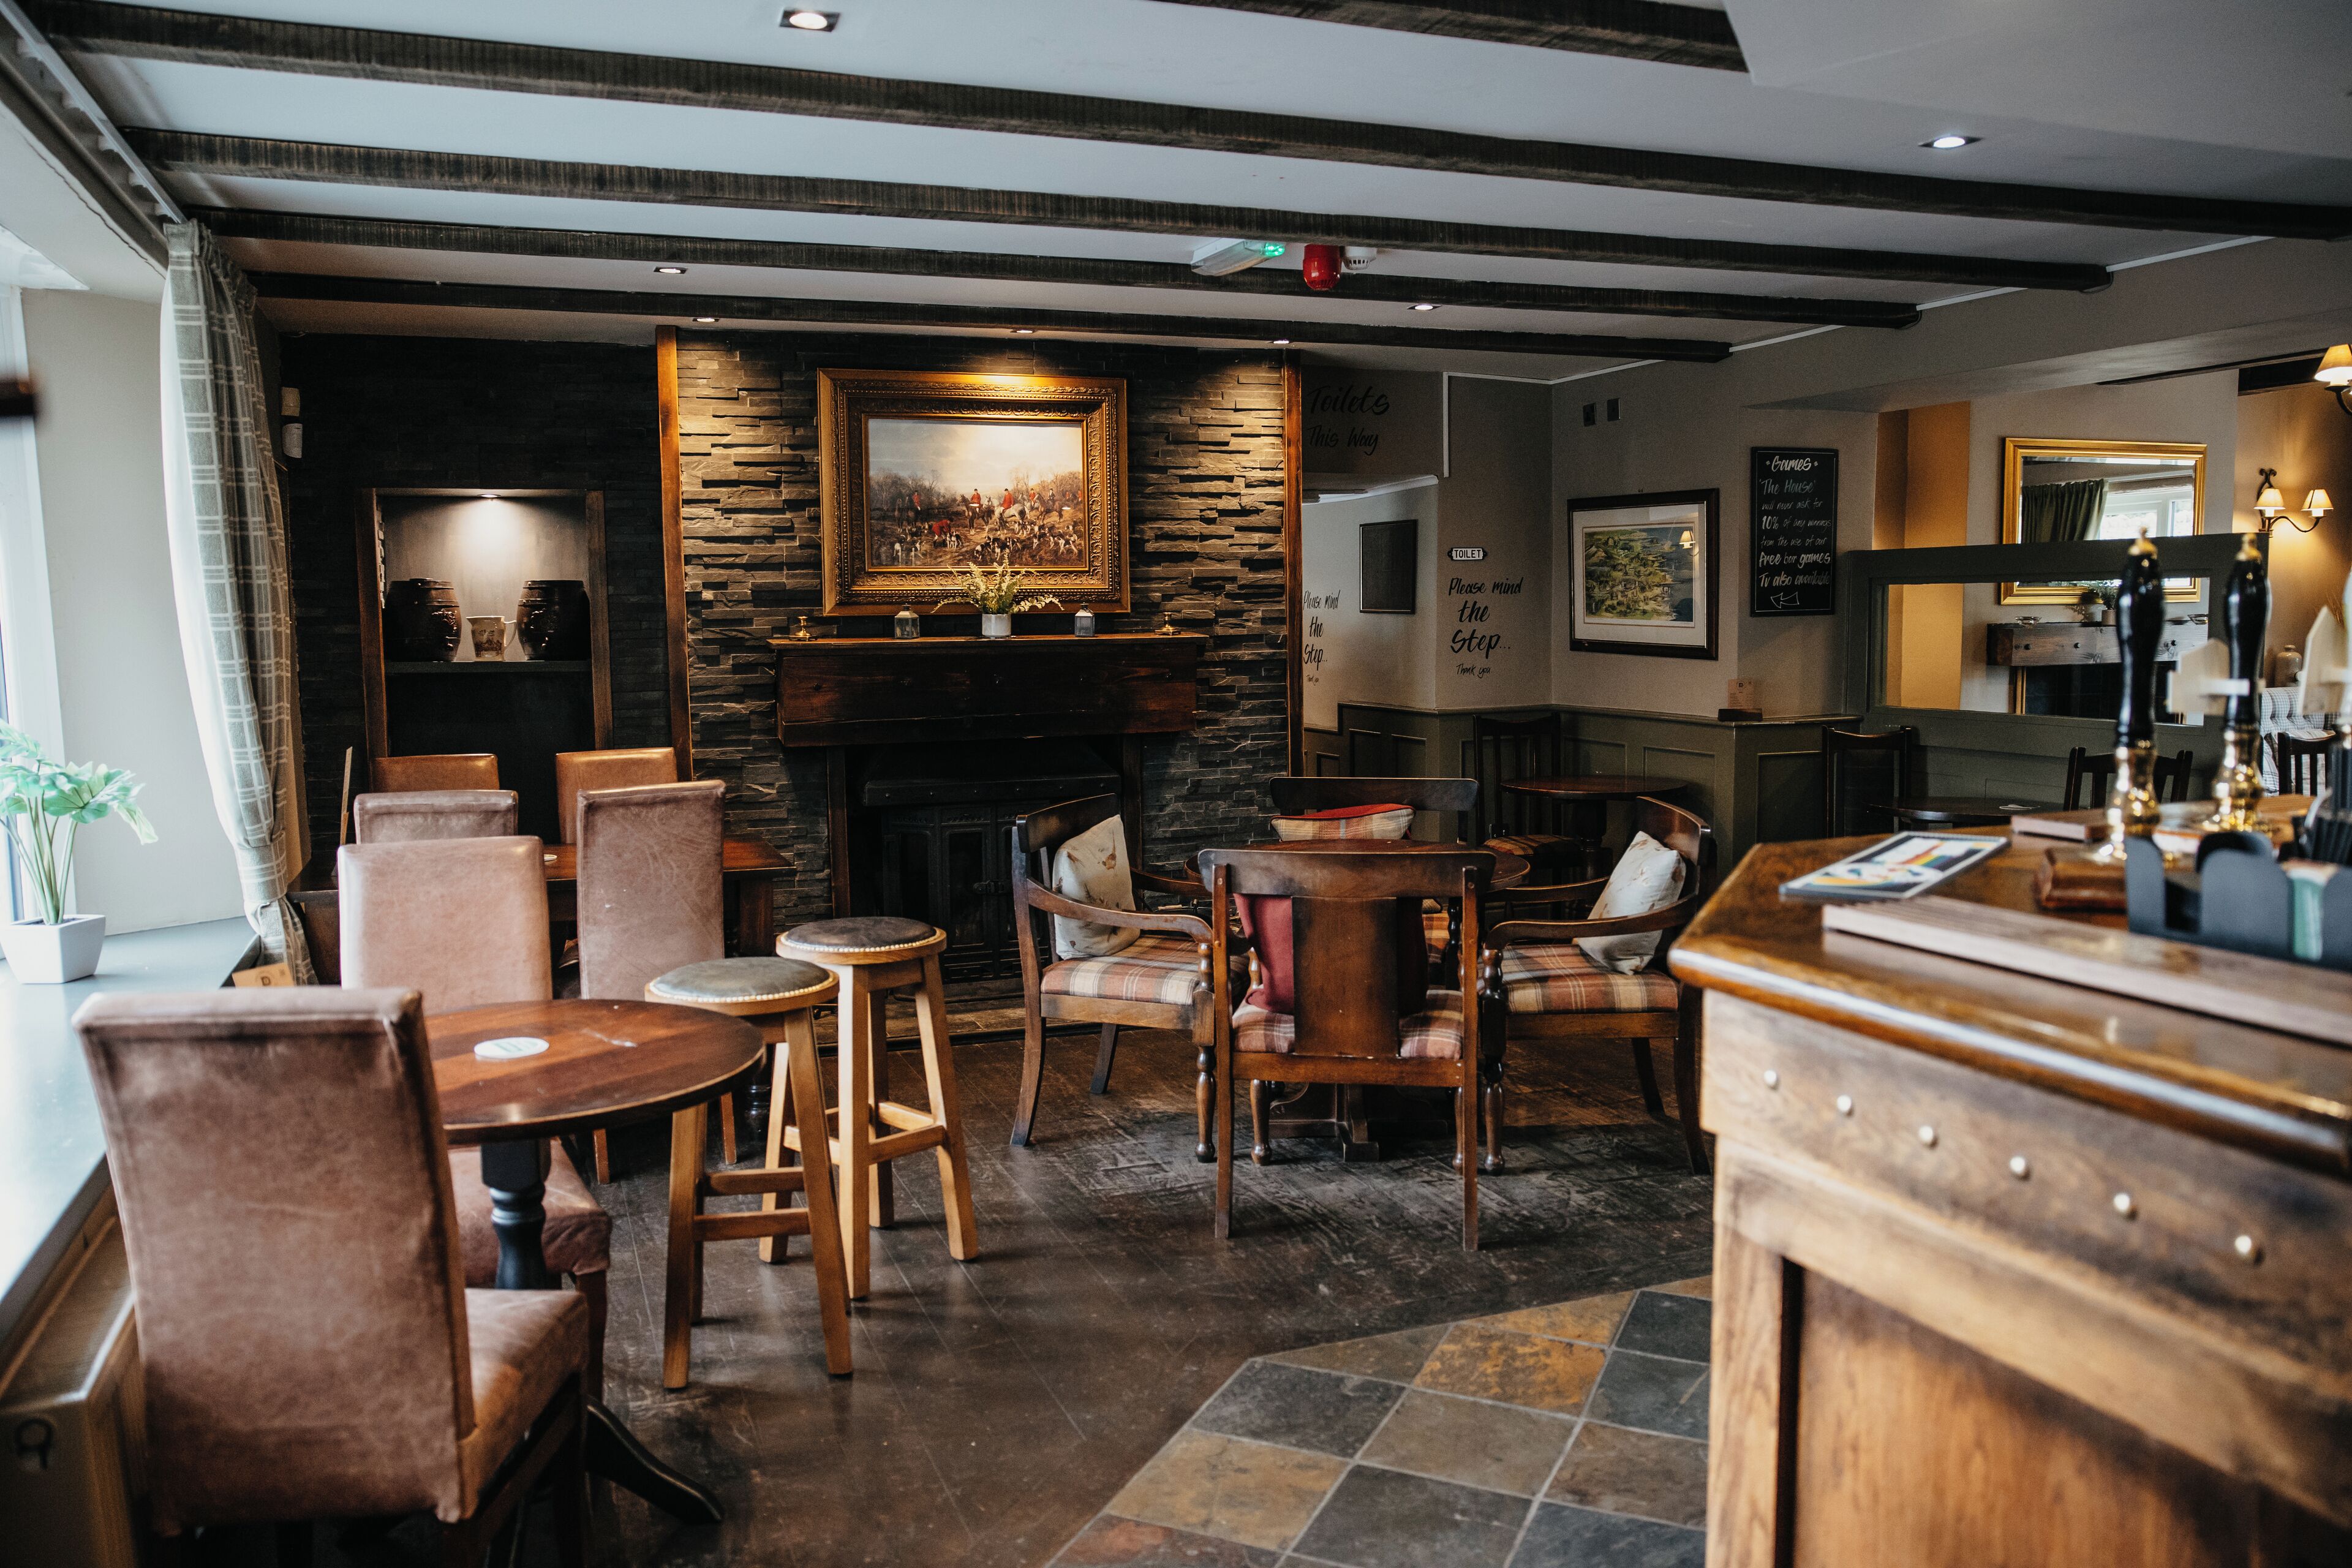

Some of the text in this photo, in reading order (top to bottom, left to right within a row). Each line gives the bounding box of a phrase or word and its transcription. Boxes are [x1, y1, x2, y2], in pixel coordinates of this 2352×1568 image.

[1307, 385, 1390, 415] Toilets
[1308, 424, 1379, 456] This Way
[1771, 456, 1811, 472] Games
[1762, 497, 1823, 510] will never ask for
[1762, 516, 1779, 530] 10%
[1783, 516, 1792, 529] of
[1793, 519, 1806, 532] any
[1760, 535, 1774, 549] from
[1777, 535, 1789, 547] the
[1805, 535, 1815, 546] of
[1815, 537, 1828, 546] our
[1454, 549, 1481, 559] TOILET
[1759, 552, 1831, 569] free bar games
[1448, 577, 1524, 596] Please mind
[1773, 571, 1792, 586] also
[1303, 589, 1341, 611] Please mind
[1458, 600, 1490, 623] the
[1309, 616, 1324, 638] the
[1450, 629, 1510, 659] Step...
[1456, 663, 1490, 679] Thank you
